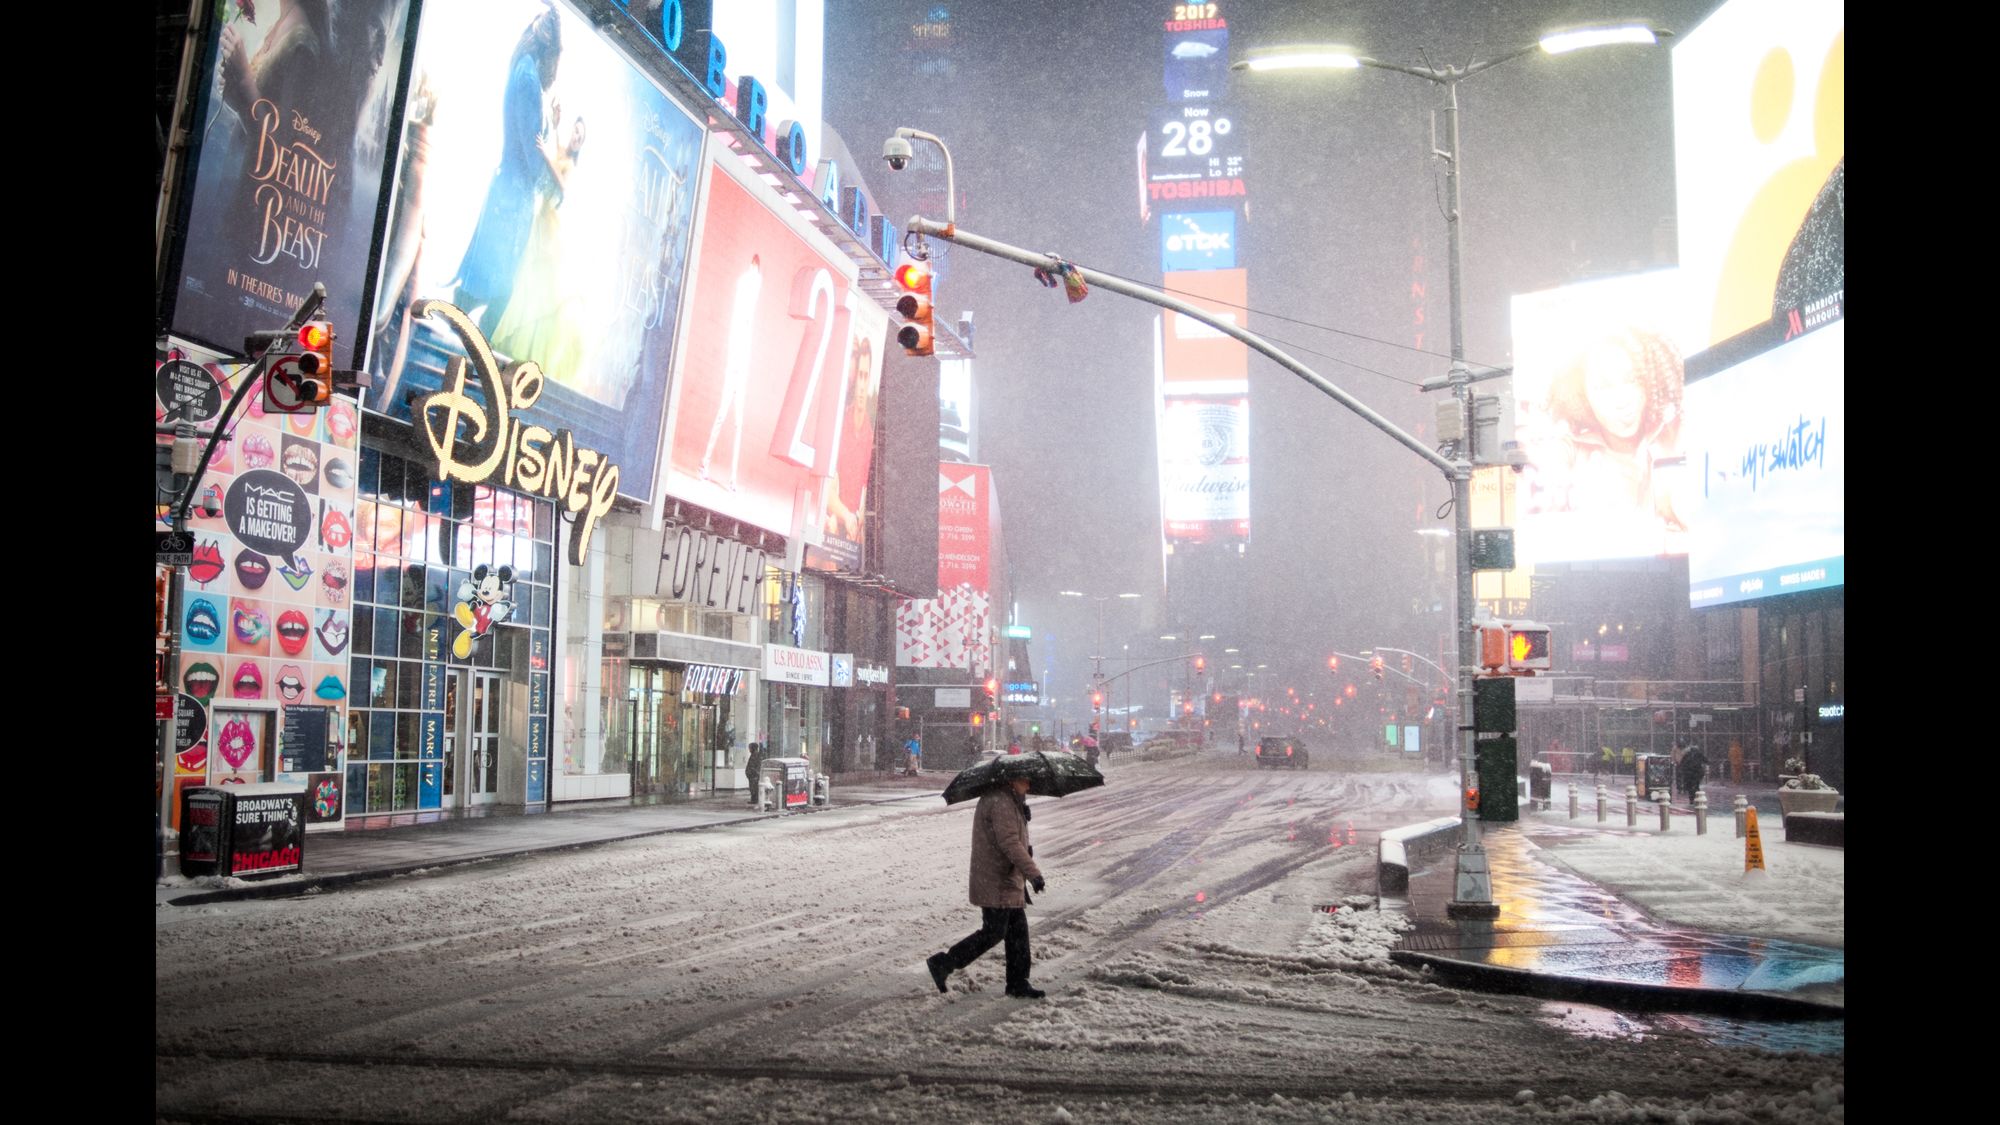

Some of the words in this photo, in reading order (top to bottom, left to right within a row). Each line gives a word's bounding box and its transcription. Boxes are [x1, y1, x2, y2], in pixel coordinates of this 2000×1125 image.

[1175, 4, 1217, 20] 2017
[1164, 16, 1228, 32] TOSHIBA
[1184, 89, 1208, 98] Snow
[1184, 107, 1208, 117] Now
[1161, 118, 1232, 156] 28°
[248, 98, 336, 206] BEAUTY
[706, 32, 898, 271] BROADW
[1209, 158, 1220, 166] Hi
[1209, 168, 1222, 177] Lo
[1148, 179, 1246, 200] TOSHIBA
[285, 196, 307, 216] AND
[309, 206, 326, 225] THE
[249, 184, 328, 269] BEAST
[1181, 232, 1230, 250] TDK
[227, 268, 238, 286] IN
[241, 274, 283, 304] THEATRES
[285, 292, 304, 310] MAR
[1805, 290, 1844, 315] MARRIOTT
[1806, 305, 1840, 328] MARQUIS
[179, 365, 190, 374] VISIT
[191, 368, 196, 376] US
[182, 375, 194, 385] TIMES
[194, 379, 210, 389] SQUARE
[246, 496, 255, 515] IS
[257, 499, 292, 523] GETTING
[239, 516, 246, 534] A
[248, 517, 296, 543] MAKEOVER!
[174, 554, 189, 563] PATH
[655, 520, 766, 615] FOREVER
[430, 629, 438, 642] IN
[535, 641, 541, 653] IN
[774, 649, 785, 665] U.S.
[787, 652, 805, 668] POLO
[684, 665, 730, 694] FOREVER
[730, 670, 743, 695] 21
[786, 671, 799, 680] SINCE
[1818, 705, 1844, 717] swatch
[236, 798, 292, 812] BROADWAY'S
[236, 812, 260, 824] SURE
[262, 810, 288, 822] THING
[233, 847, 300, 872] CHICAGO
